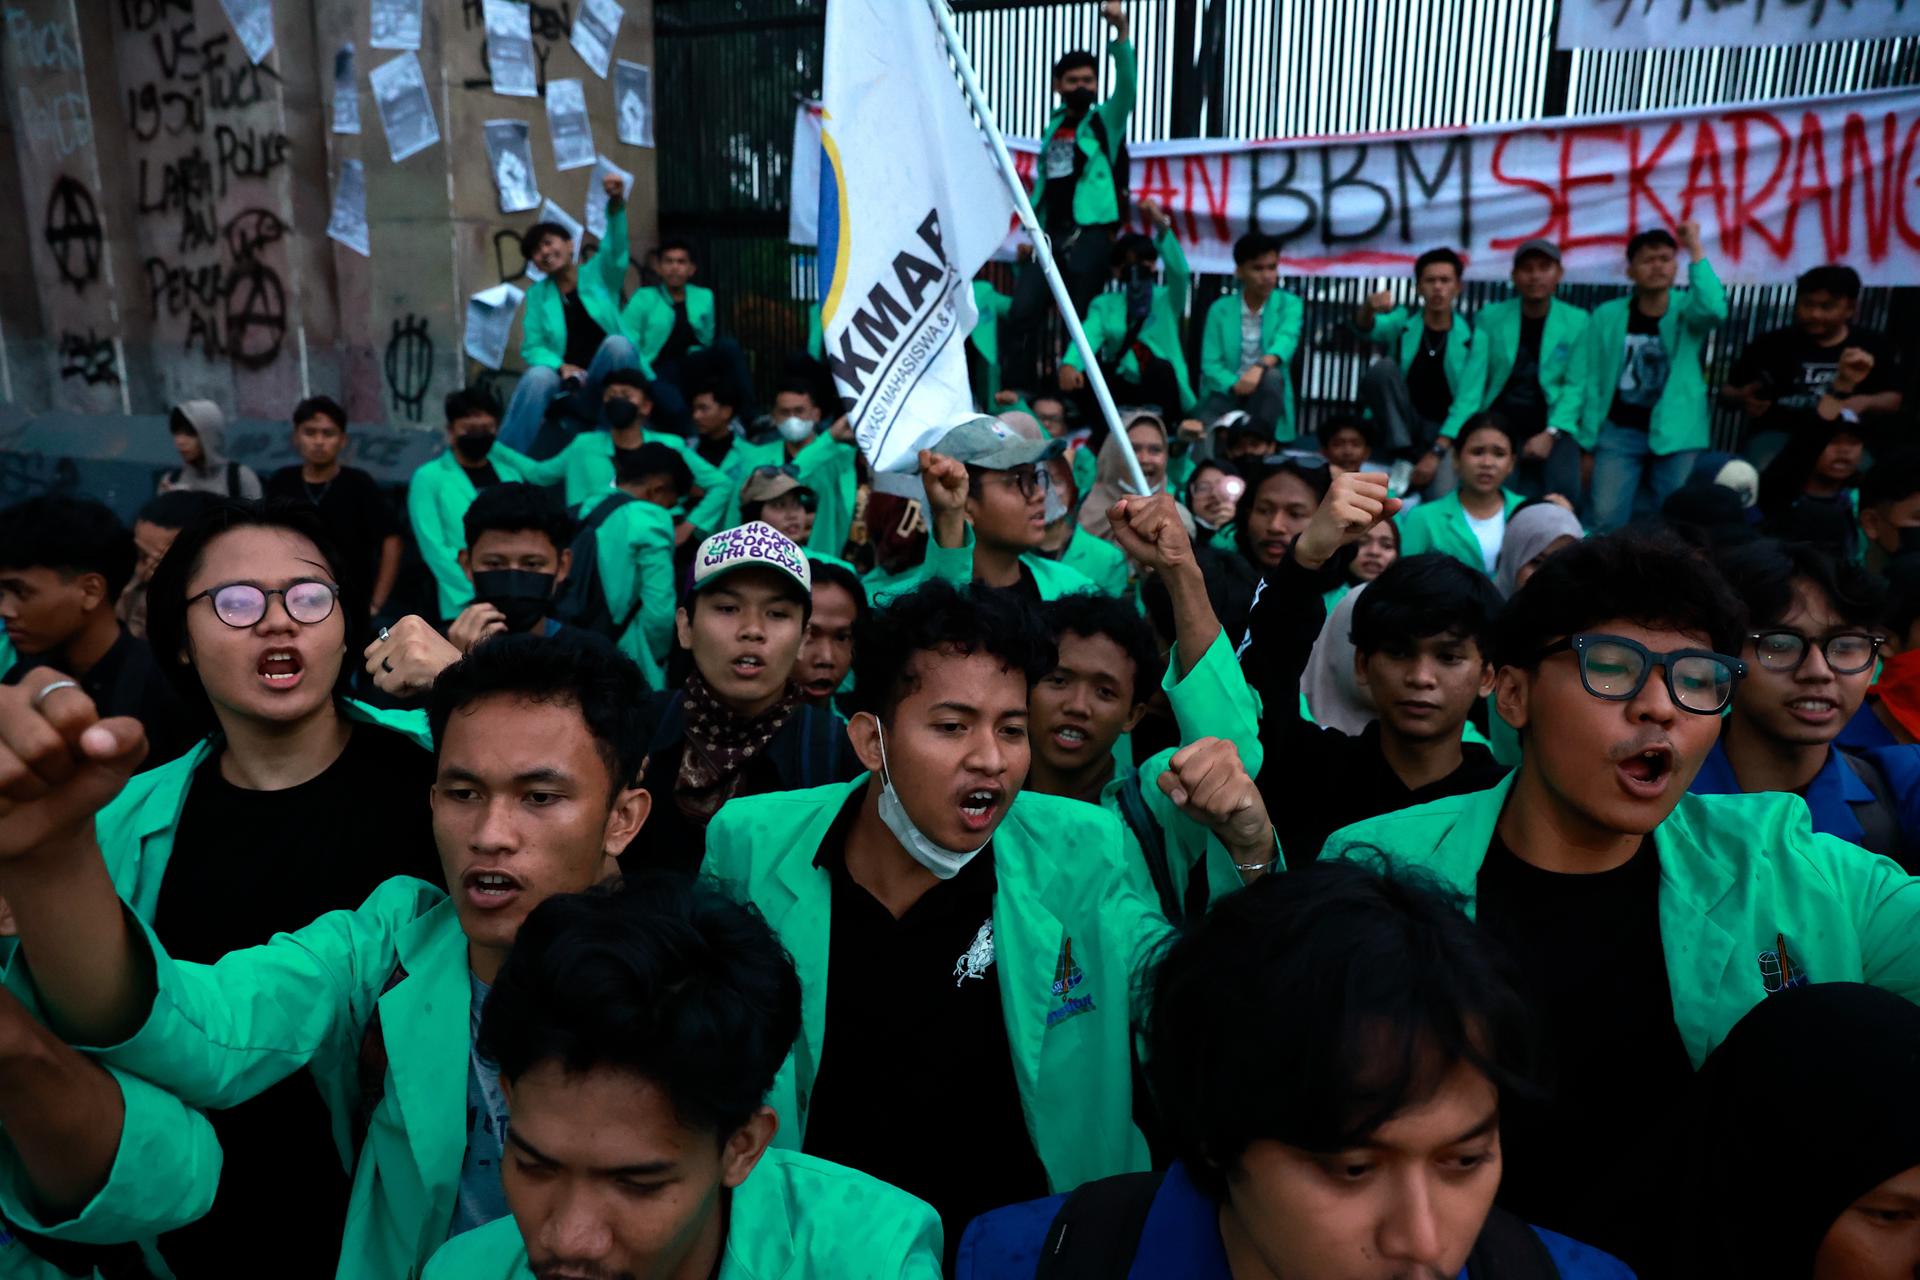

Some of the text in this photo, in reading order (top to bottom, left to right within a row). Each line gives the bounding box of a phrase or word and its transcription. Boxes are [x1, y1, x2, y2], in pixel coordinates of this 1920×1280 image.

[1124, 154, 1231, 245] AN
[1248, 135, 1472, 246] BBM
[829, 207, 948, 412] KMAP
[880, 325, 943, 406] MAHASISWA
[704, 545, 745, 567] WITH
